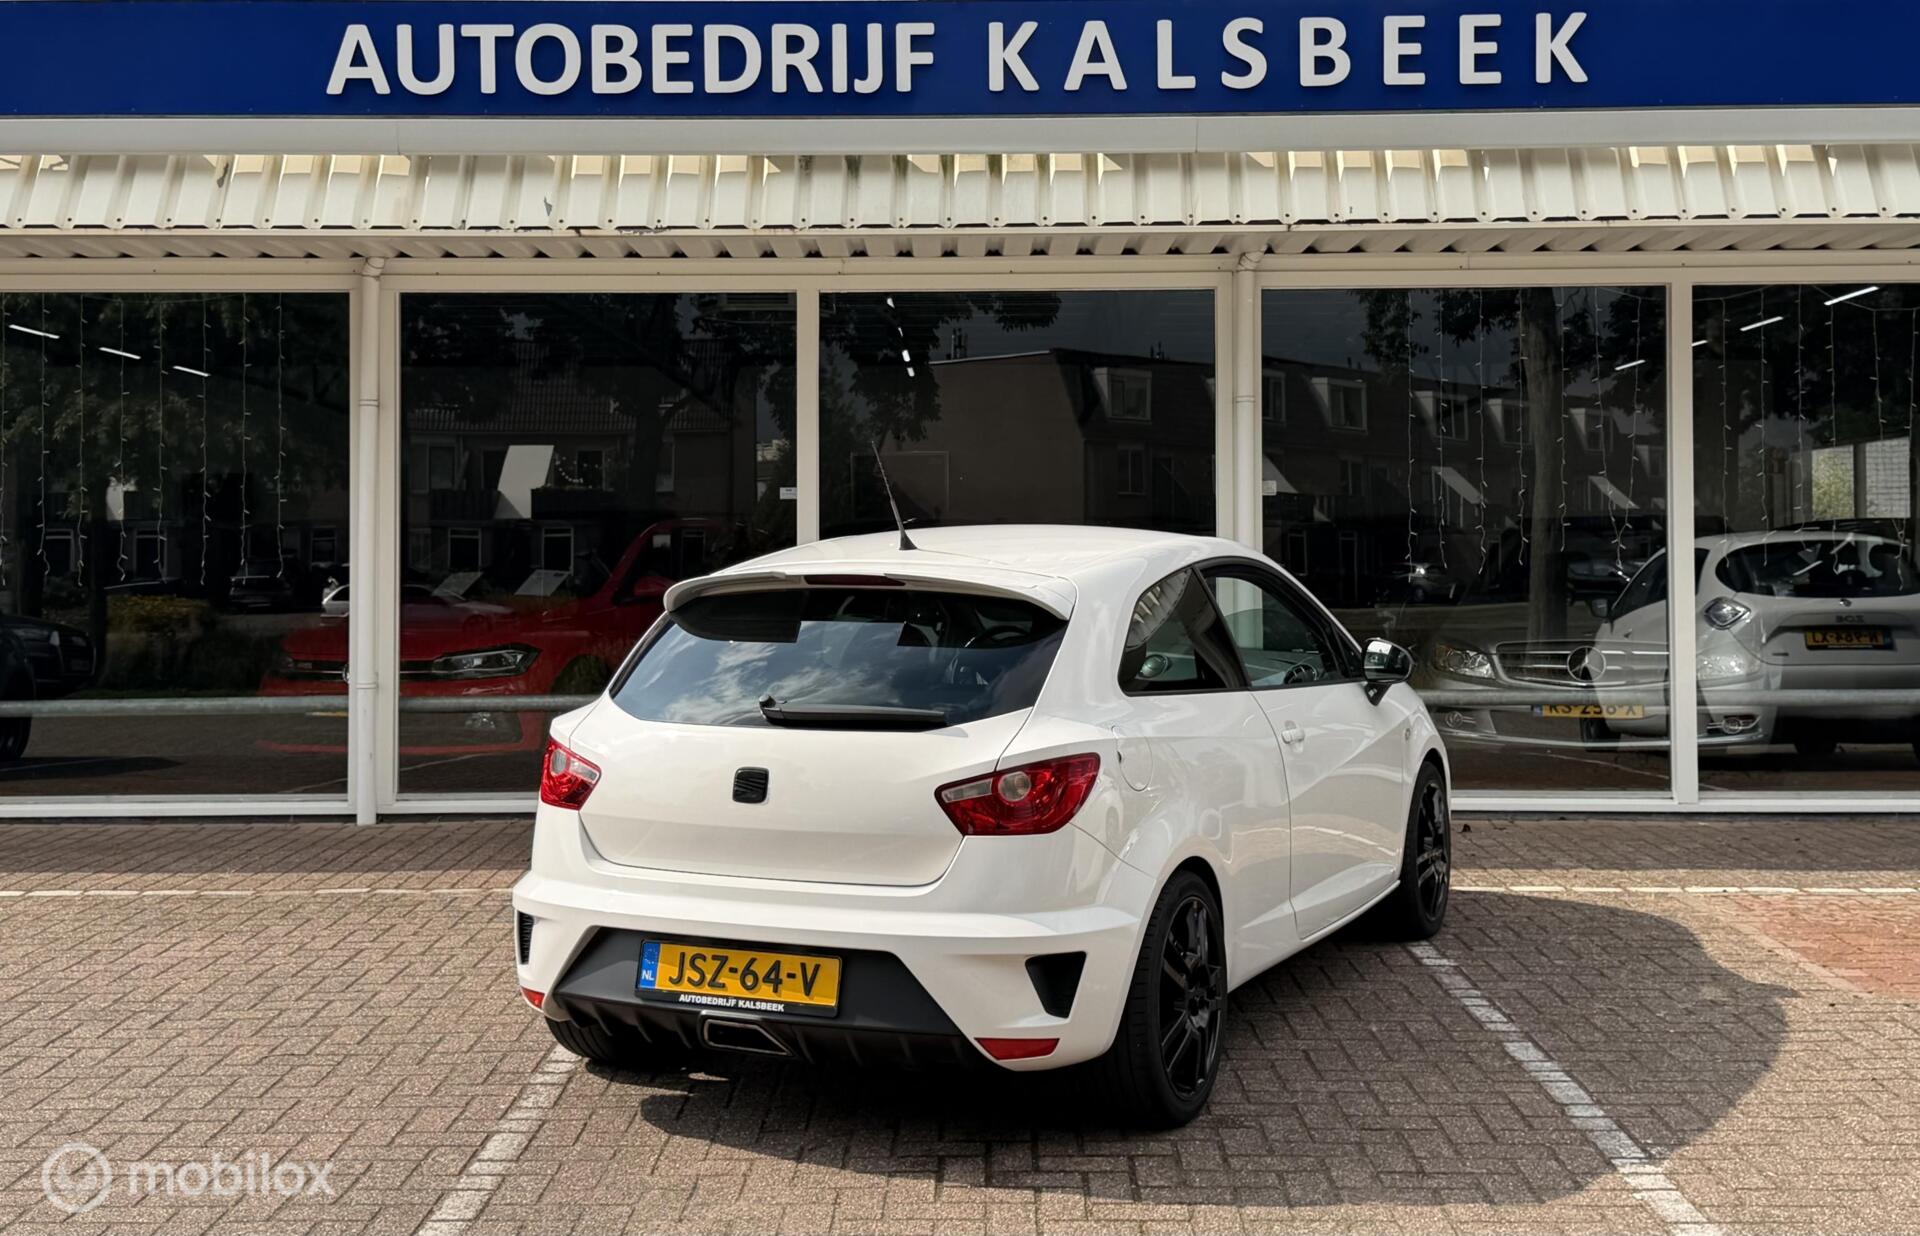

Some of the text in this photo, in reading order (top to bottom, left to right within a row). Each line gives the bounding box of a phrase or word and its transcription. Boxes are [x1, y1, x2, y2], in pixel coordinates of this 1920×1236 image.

[326, 12, 1589, 95] AUTOBEDRIJF KALSBEEK
[641, 969, 654, 981] NL
[668, 951, 821, 997] JSZ-64-V
[679, 994, 784, 1012] AUTOBEDRIJF KALSBEEK
